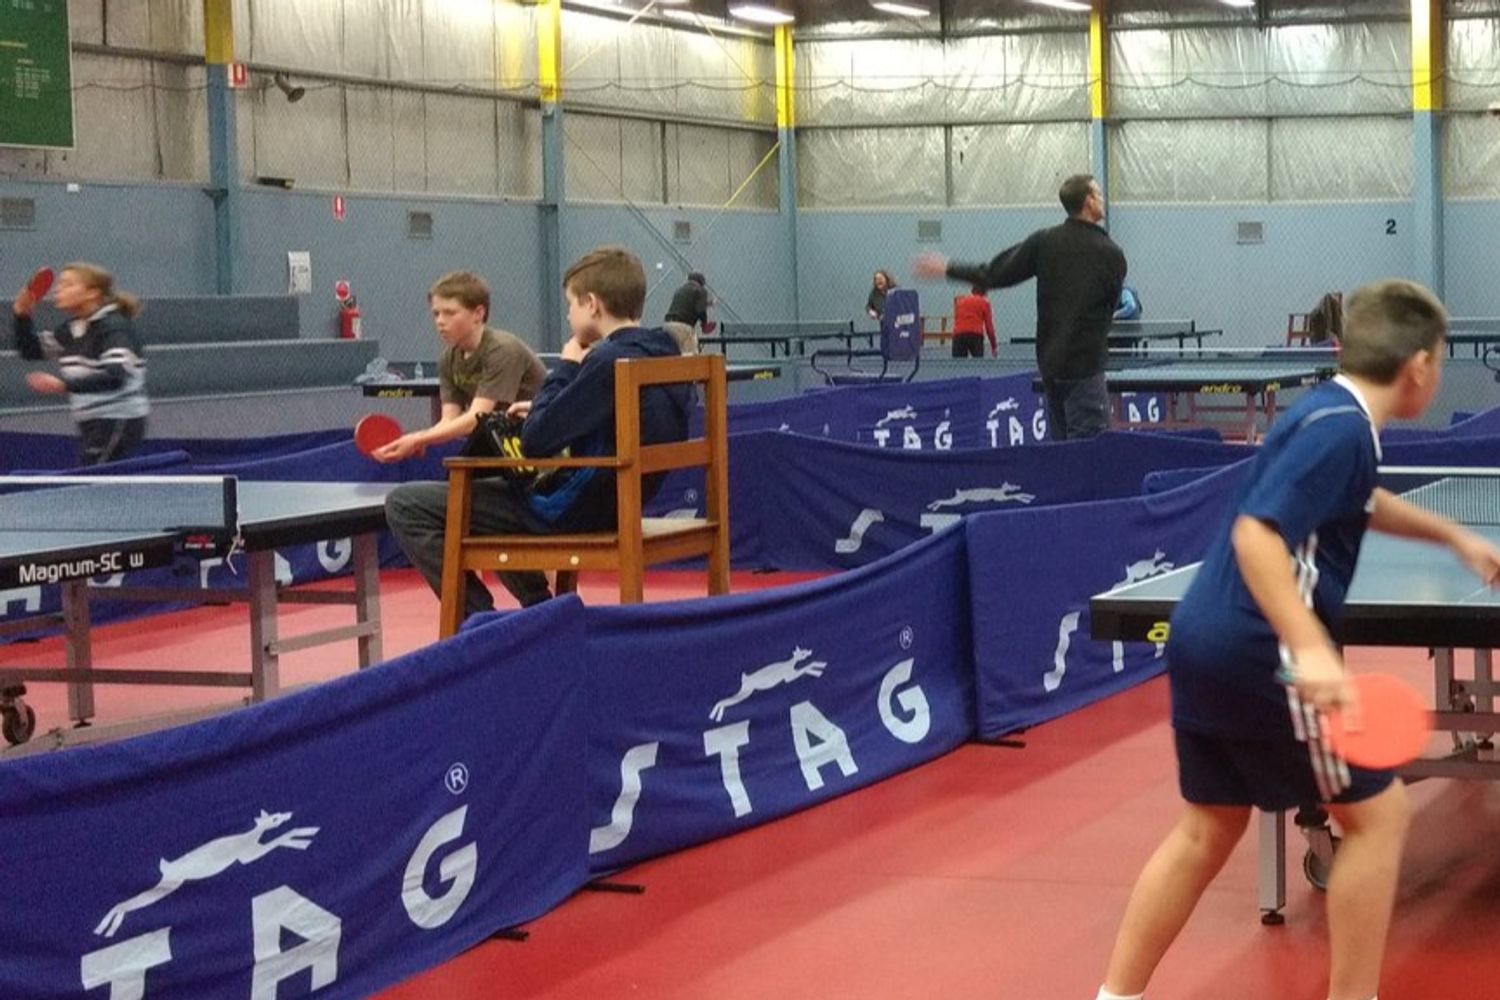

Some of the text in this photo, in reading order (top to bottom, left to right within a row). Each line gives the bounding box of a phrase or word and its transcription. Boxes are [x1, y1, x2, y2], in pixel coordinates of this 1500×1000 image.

[1385, 218, 1397, 235] 2
[18, 551, 122, 584] Magnum-SC
[588, 657, 931, 854] STAG
